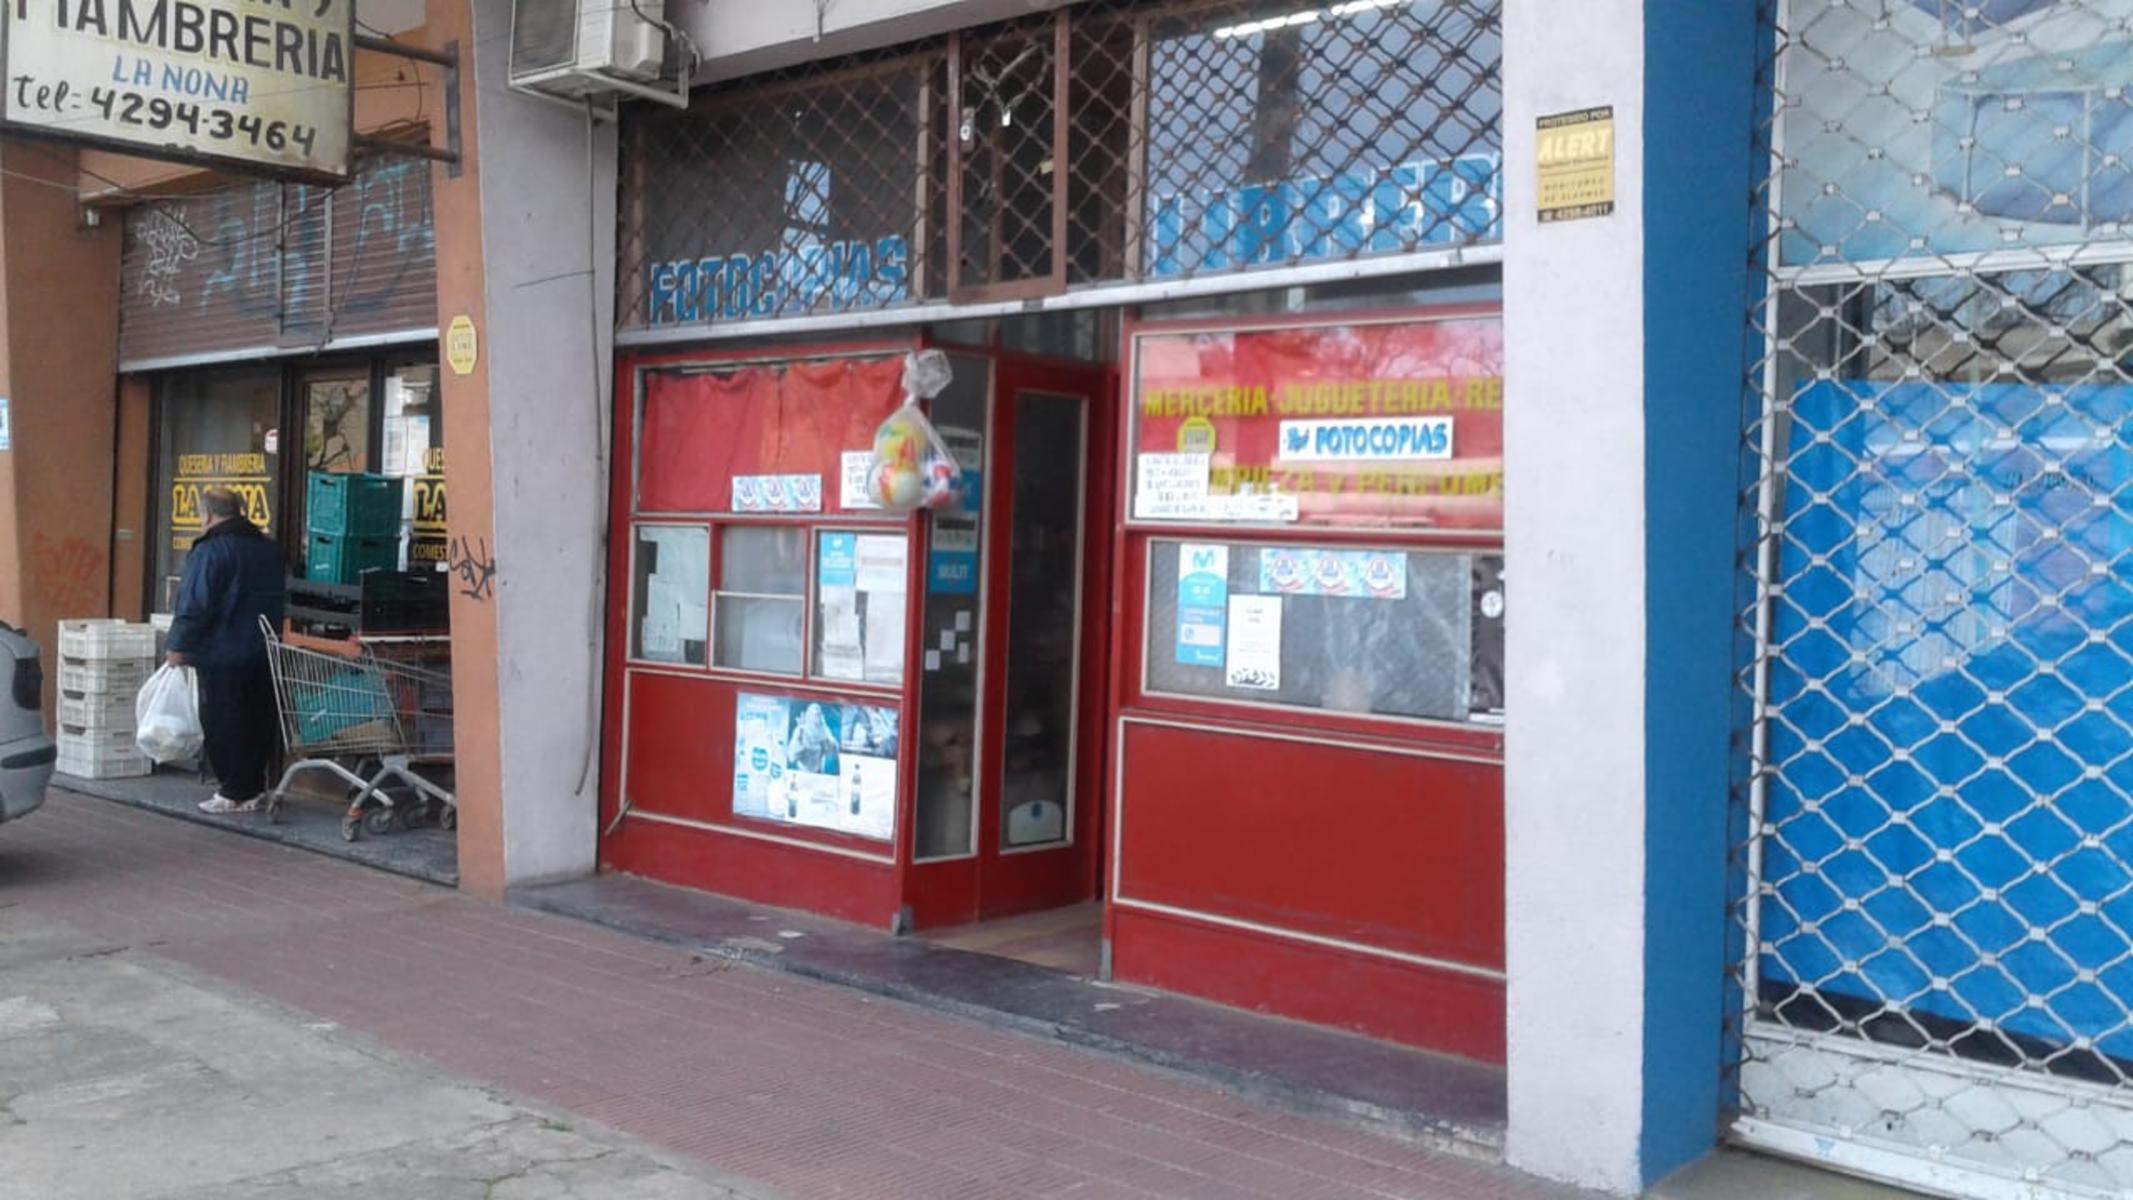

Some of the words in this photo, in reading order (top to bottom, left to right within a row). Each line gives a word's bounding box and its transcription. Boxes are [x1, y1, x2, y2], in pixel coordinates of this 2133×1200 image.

[112, 55, 152, 87] LA
[162, 62, 249, 105] NONA
[91, 86, 316, 157] 4294-3464
[1538, 129, 1611, 162] ALERT
[651, 235, 908, 328] FOTOCOPIAS
[1145, 384, 1269, 417] MERCERIA
[1277, 378, 1451, 416] JUGUETERIA
[1315, 422, 1449, 456] FOTOCOPIAS
[173, 484, 202, 525] LA
[413, 483, 447, 528] LA
